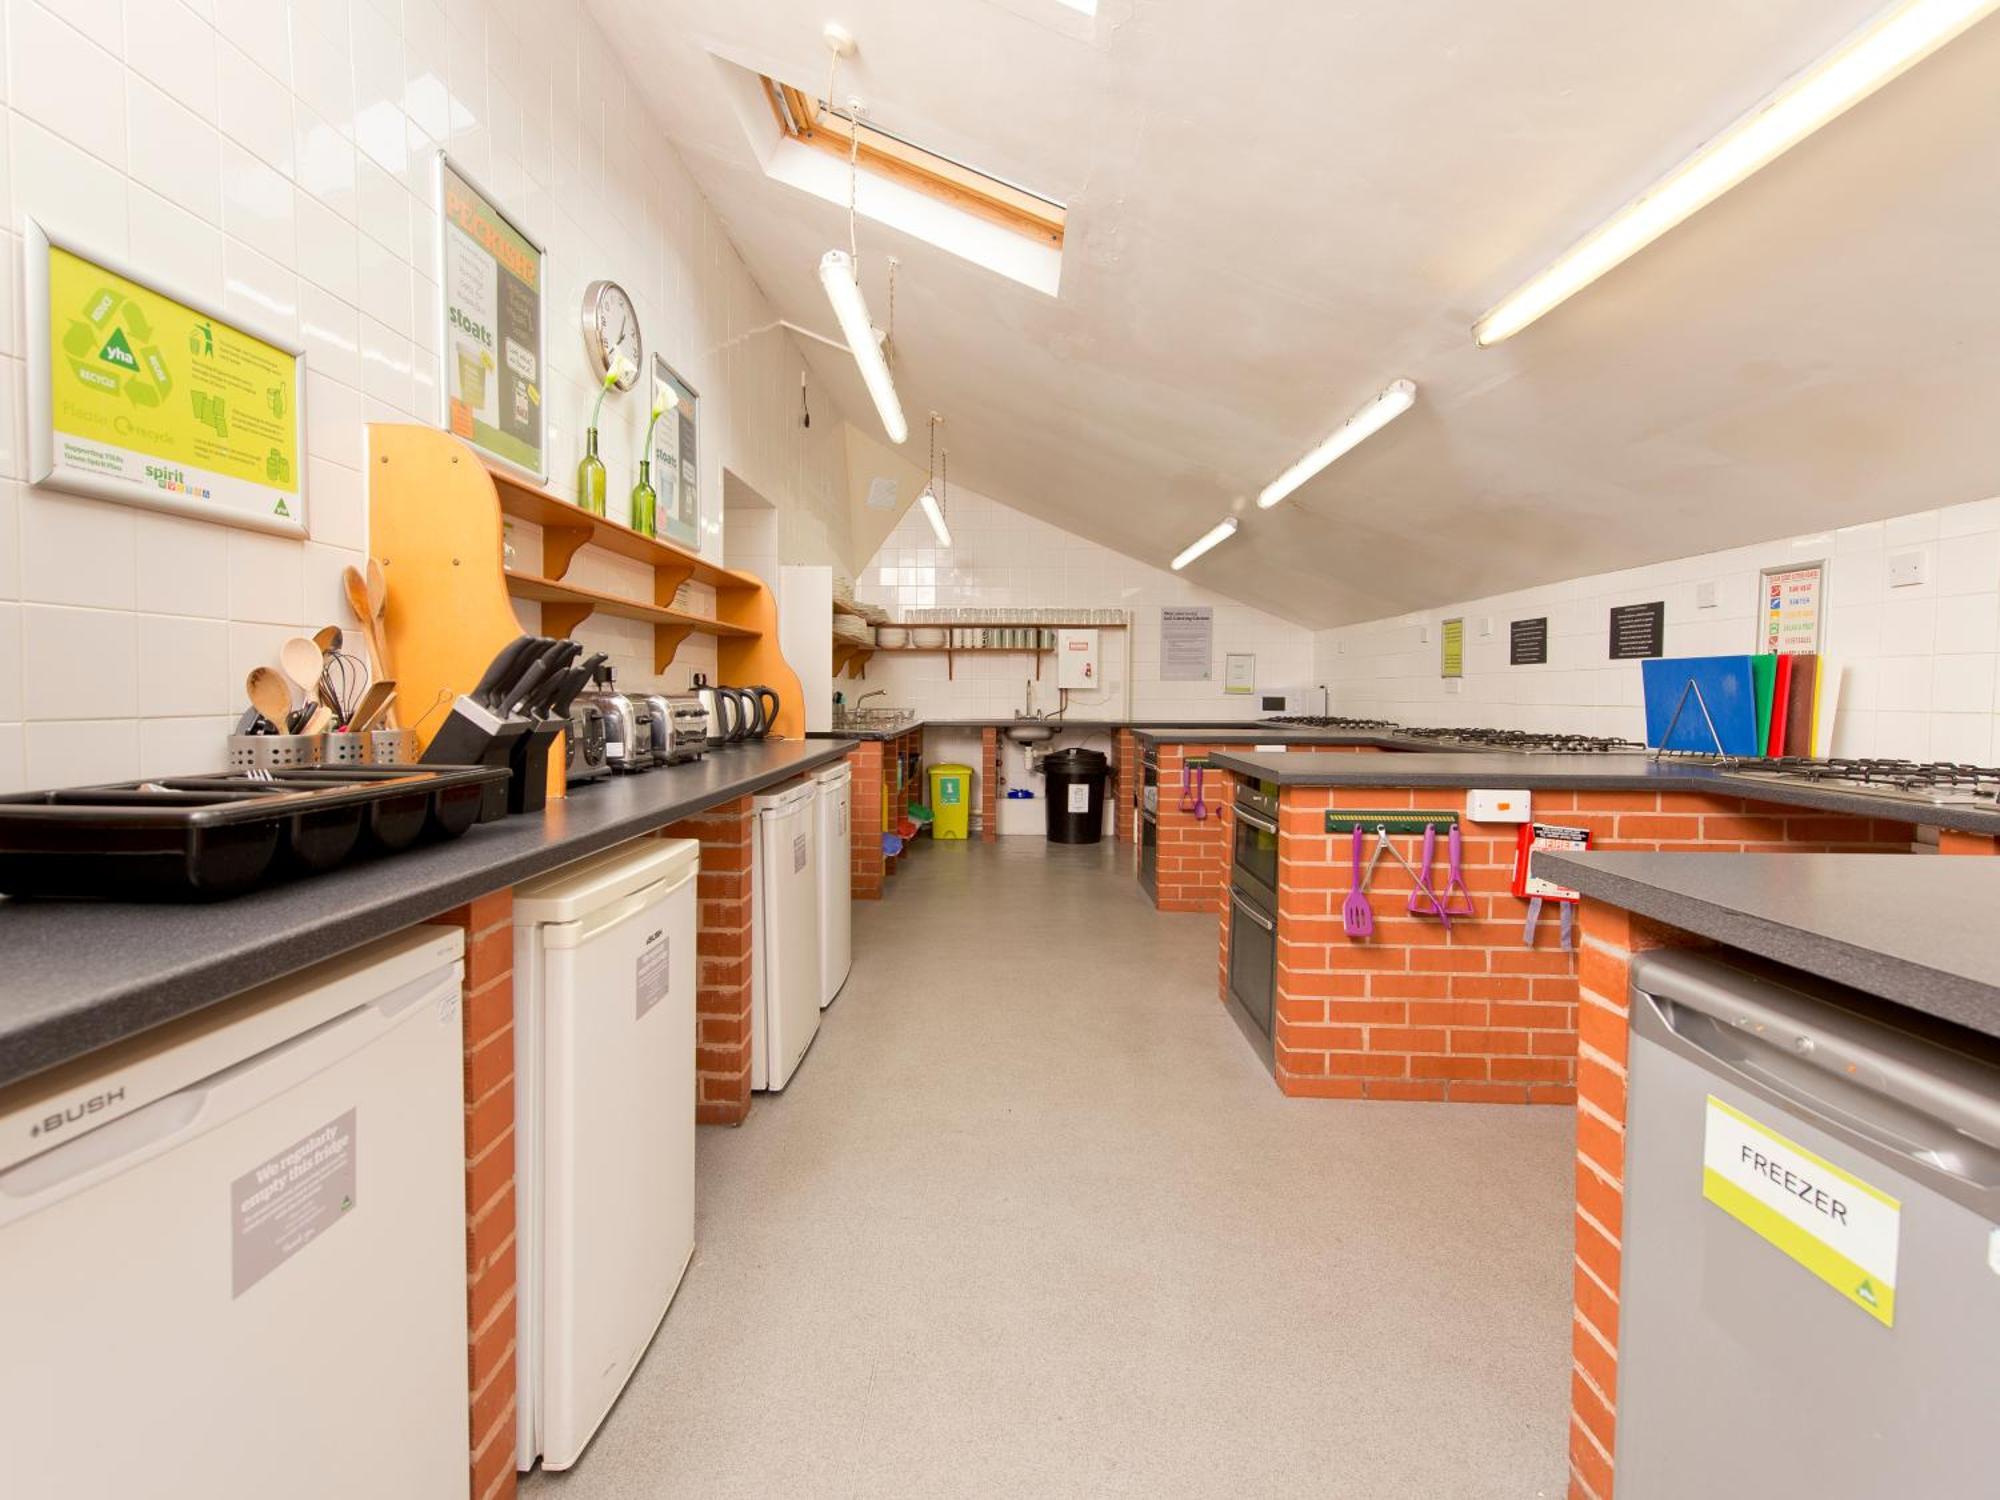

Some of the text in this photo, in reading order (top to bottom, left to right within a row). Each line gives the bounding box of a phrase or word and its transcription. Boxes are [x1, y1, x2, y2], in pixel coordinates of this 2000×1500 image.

[449, 306, 492, 347] stoats
[106, 346, 134, 365] yha
[145, 464, 184, 485] spirit
[43, 1086, 125, 1133] BUSH
[240, 1134, 349, 1213] empty this fridge
[255, 1125, 338, 1184] We regularly
[1741, 1144, 1847, 1226] FREEZER
